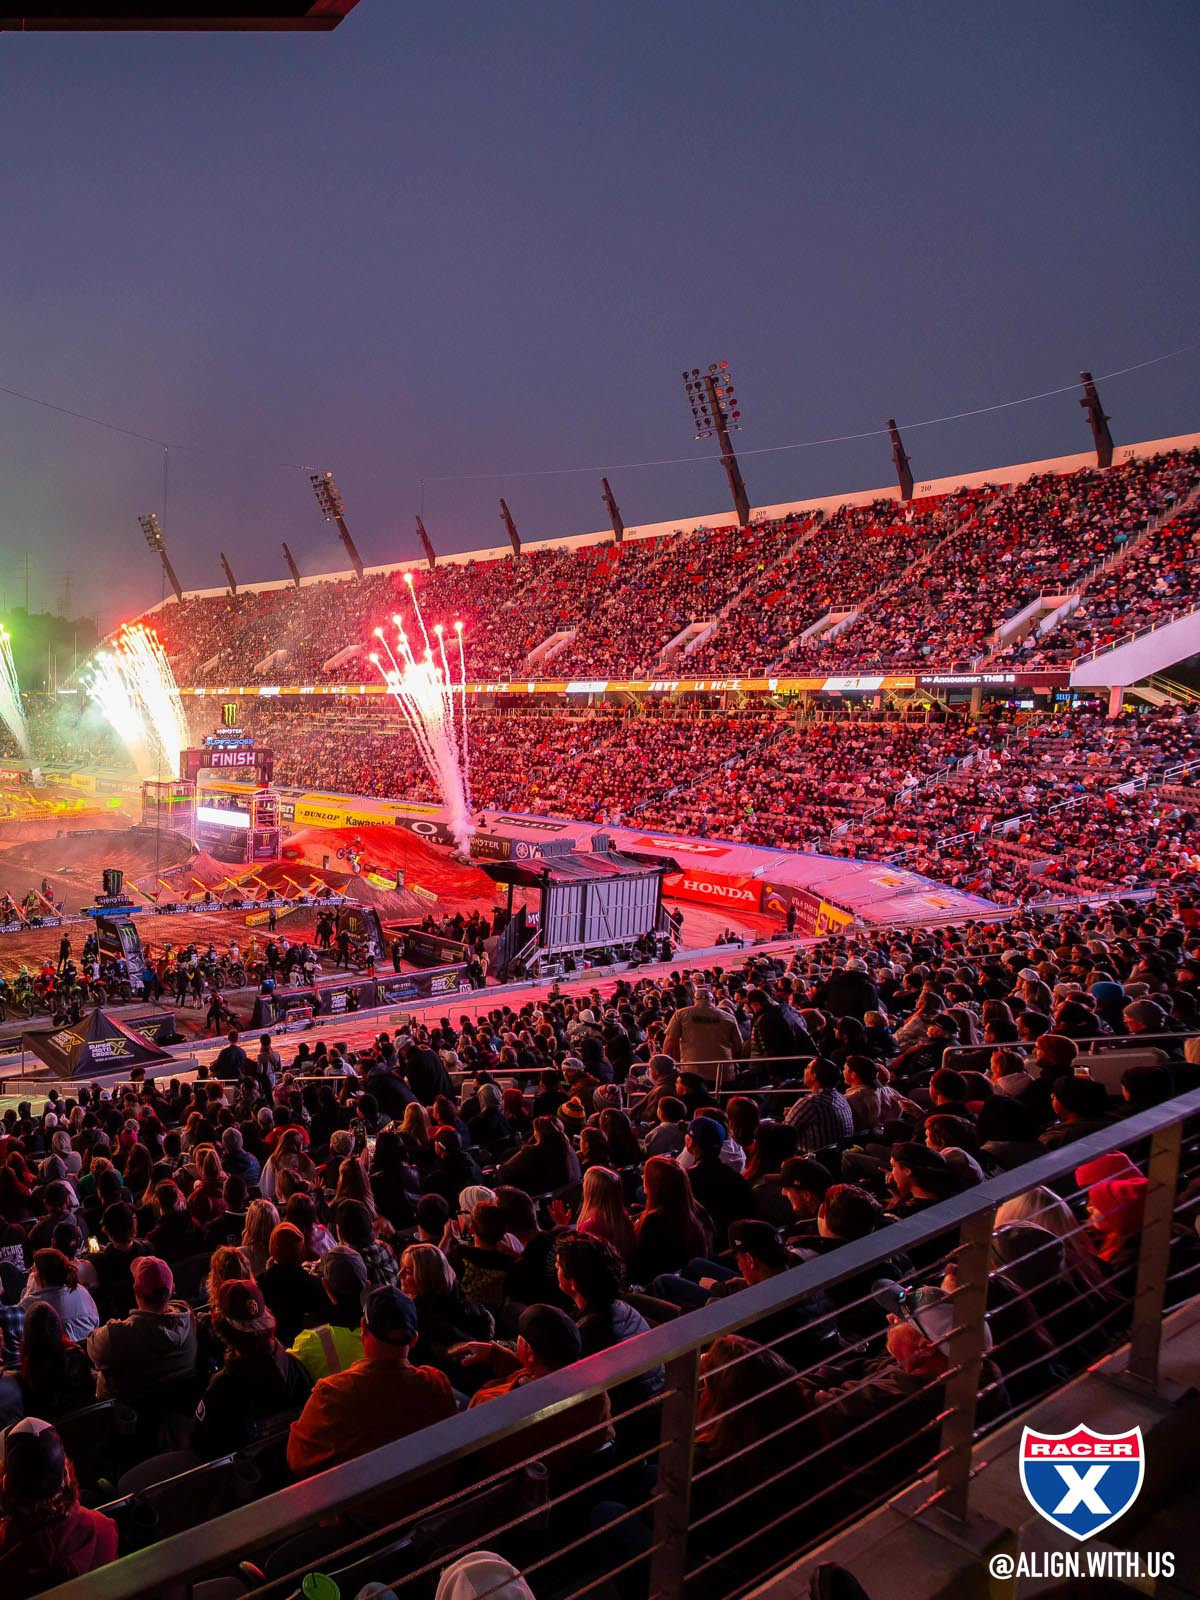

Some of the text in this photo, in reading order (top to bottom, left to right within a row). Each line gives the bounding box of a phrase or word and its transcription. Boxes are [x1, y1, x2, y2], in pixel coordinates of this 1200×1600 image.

[211, 752, 256, 767] FINISH
[303, 810, 340, 821] DUNLOP
[683, 880, 757, 901] HONDA
